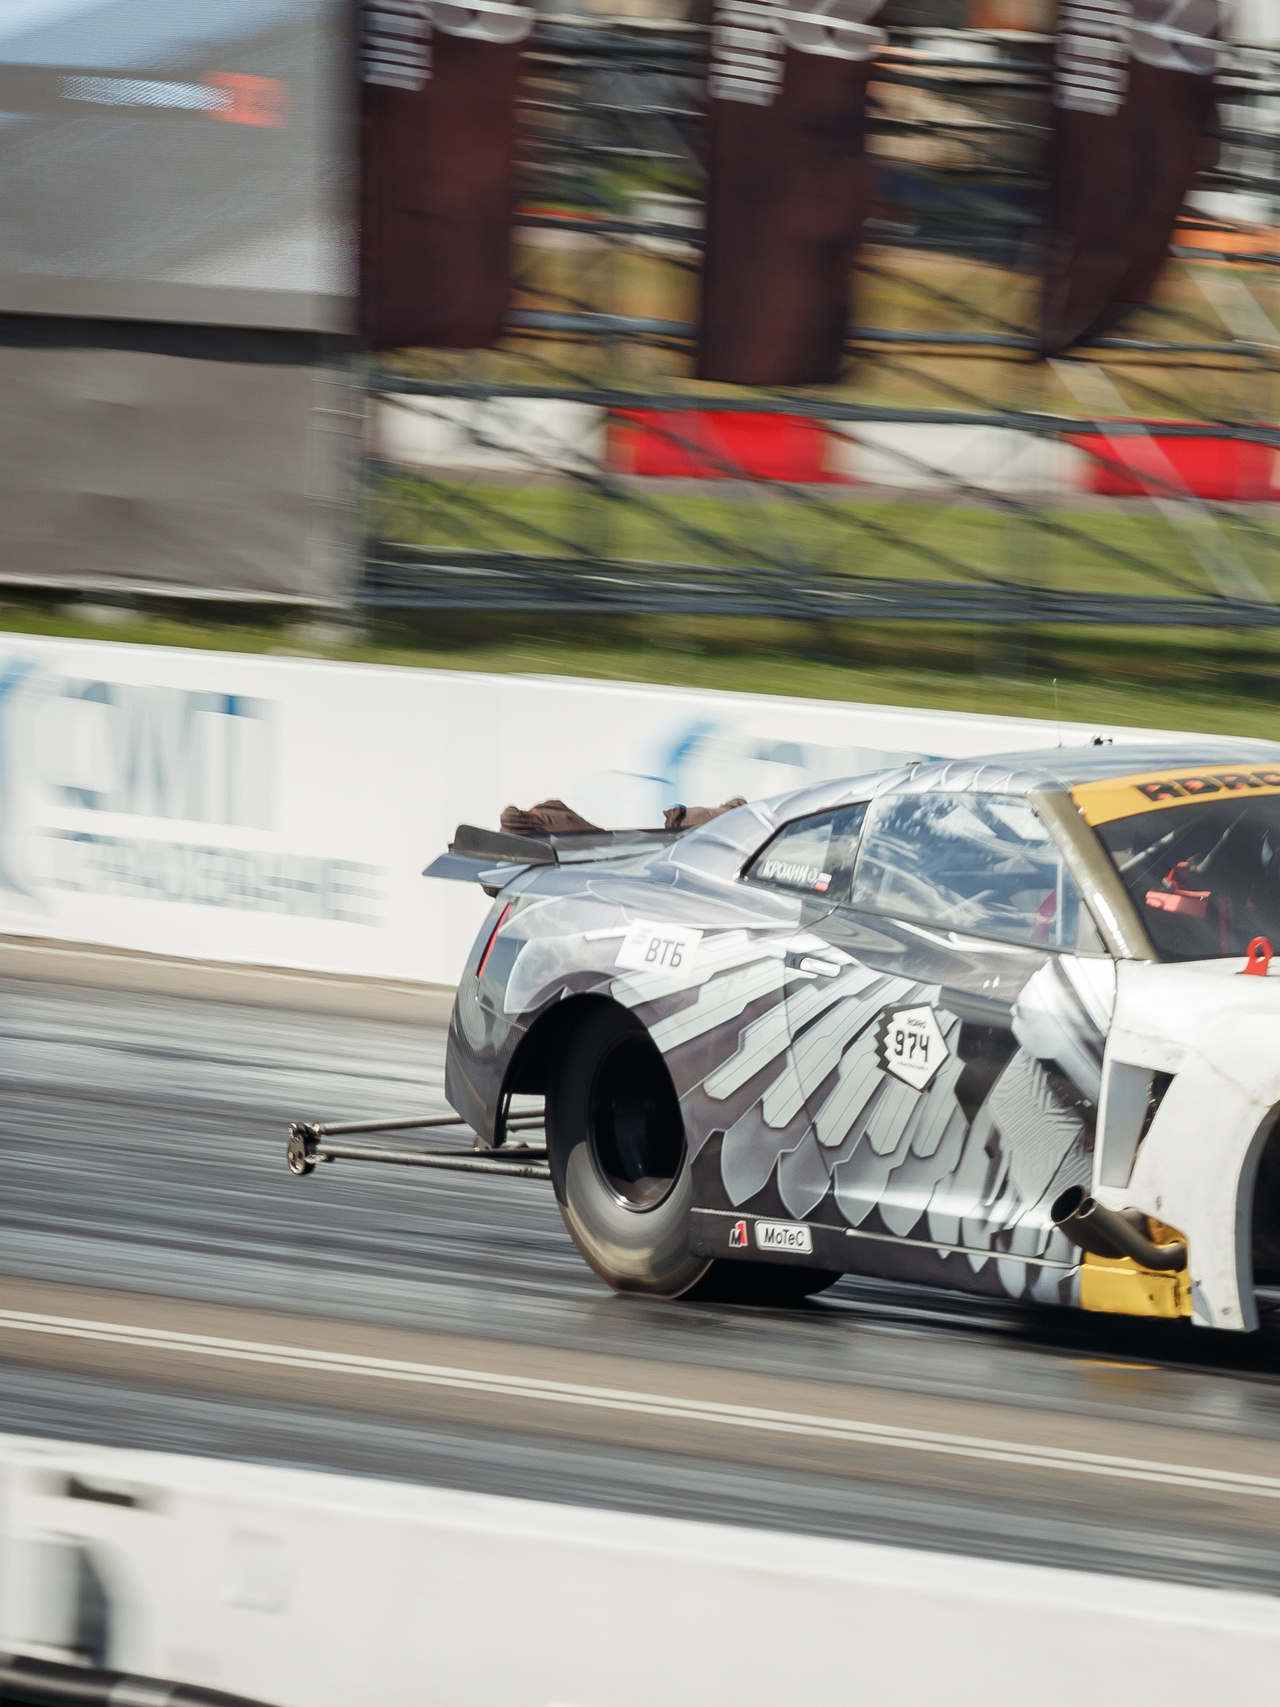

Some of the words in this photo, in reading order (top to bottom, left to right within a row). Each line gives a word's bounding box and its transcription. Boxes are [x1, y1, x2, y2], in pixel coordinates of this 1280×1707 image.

[644, 937, 686, 968] ВТБ
[895, 1030, 930, 1063] 974
[764, 1227, 805, 1247] MoTeC
